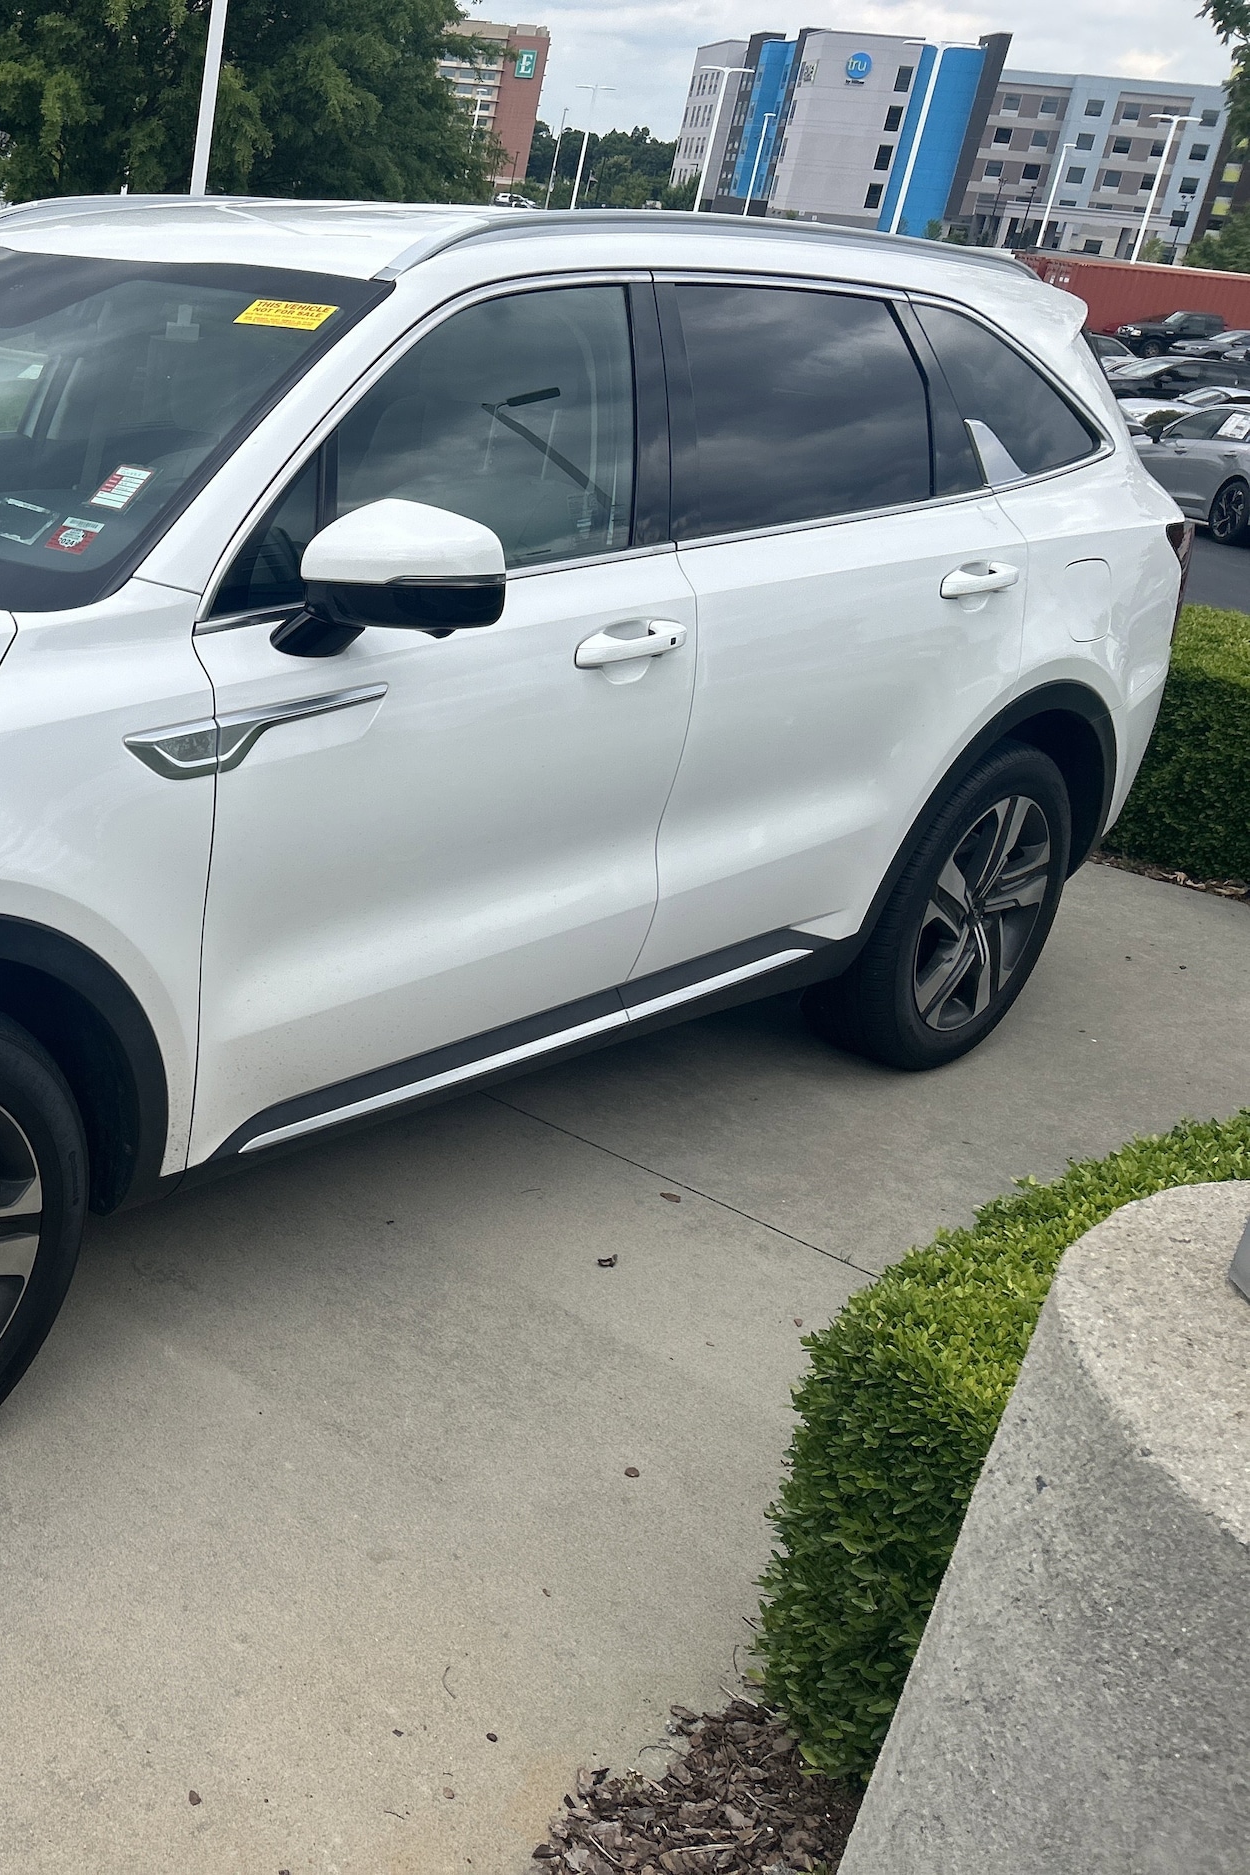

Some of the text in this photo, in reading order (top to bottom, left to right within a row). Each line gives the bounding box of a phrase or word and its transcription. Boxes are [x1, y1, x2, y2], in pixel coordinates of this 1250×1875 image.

[519, 54, 533, 74] E
[848, 57, 867, 72] tru
[284, 303, 331, 312] VEHICLE
